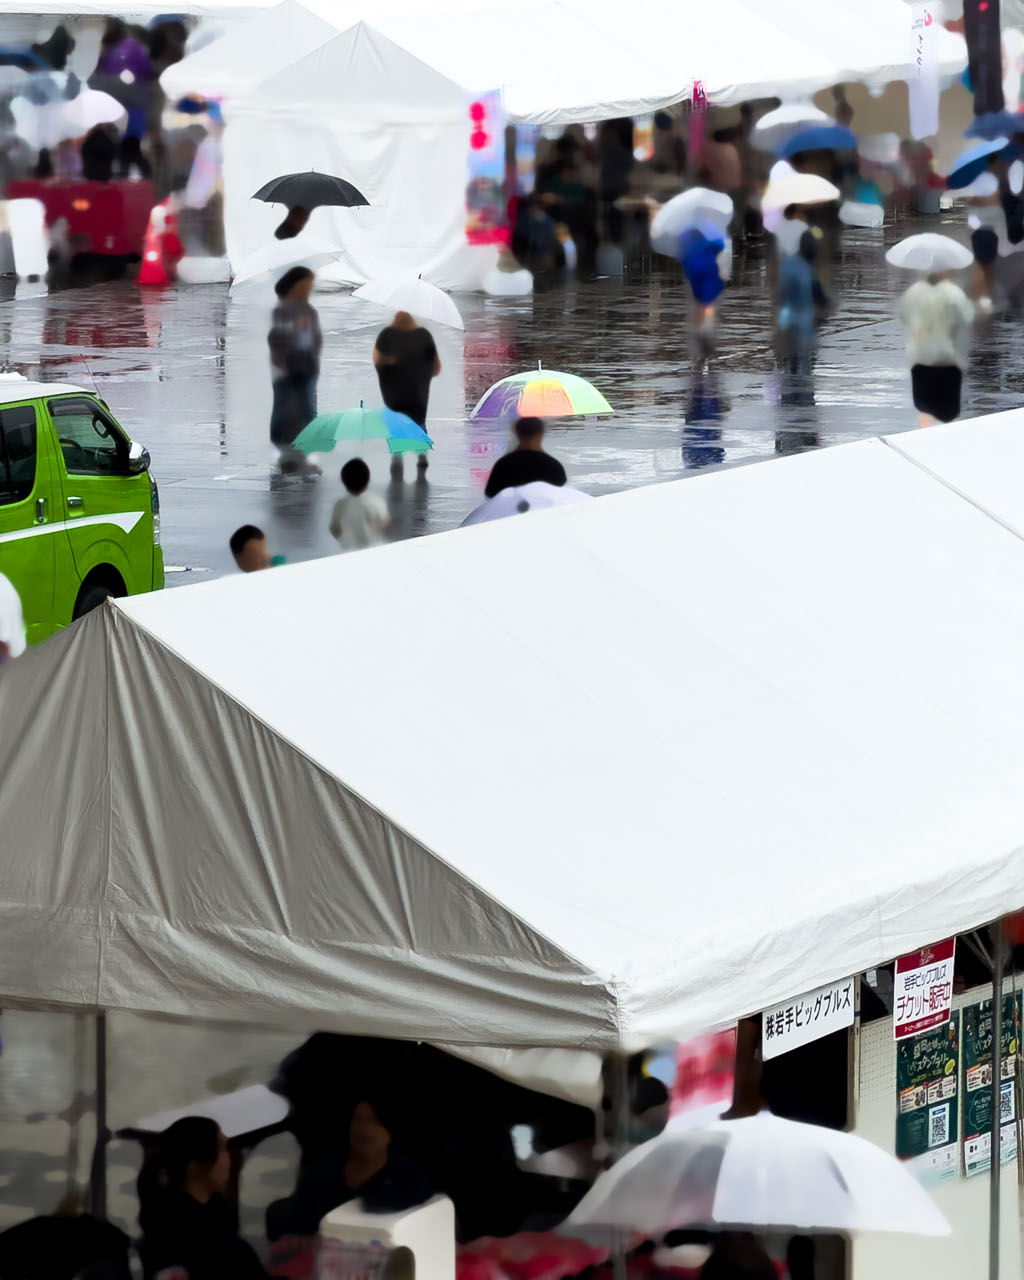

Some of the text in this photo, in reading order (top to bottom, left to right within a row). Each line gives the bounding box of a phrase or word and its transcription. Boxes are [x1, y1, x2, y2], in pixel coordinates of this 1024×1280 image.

[897, 982, 951, 1022] チケット販売中
